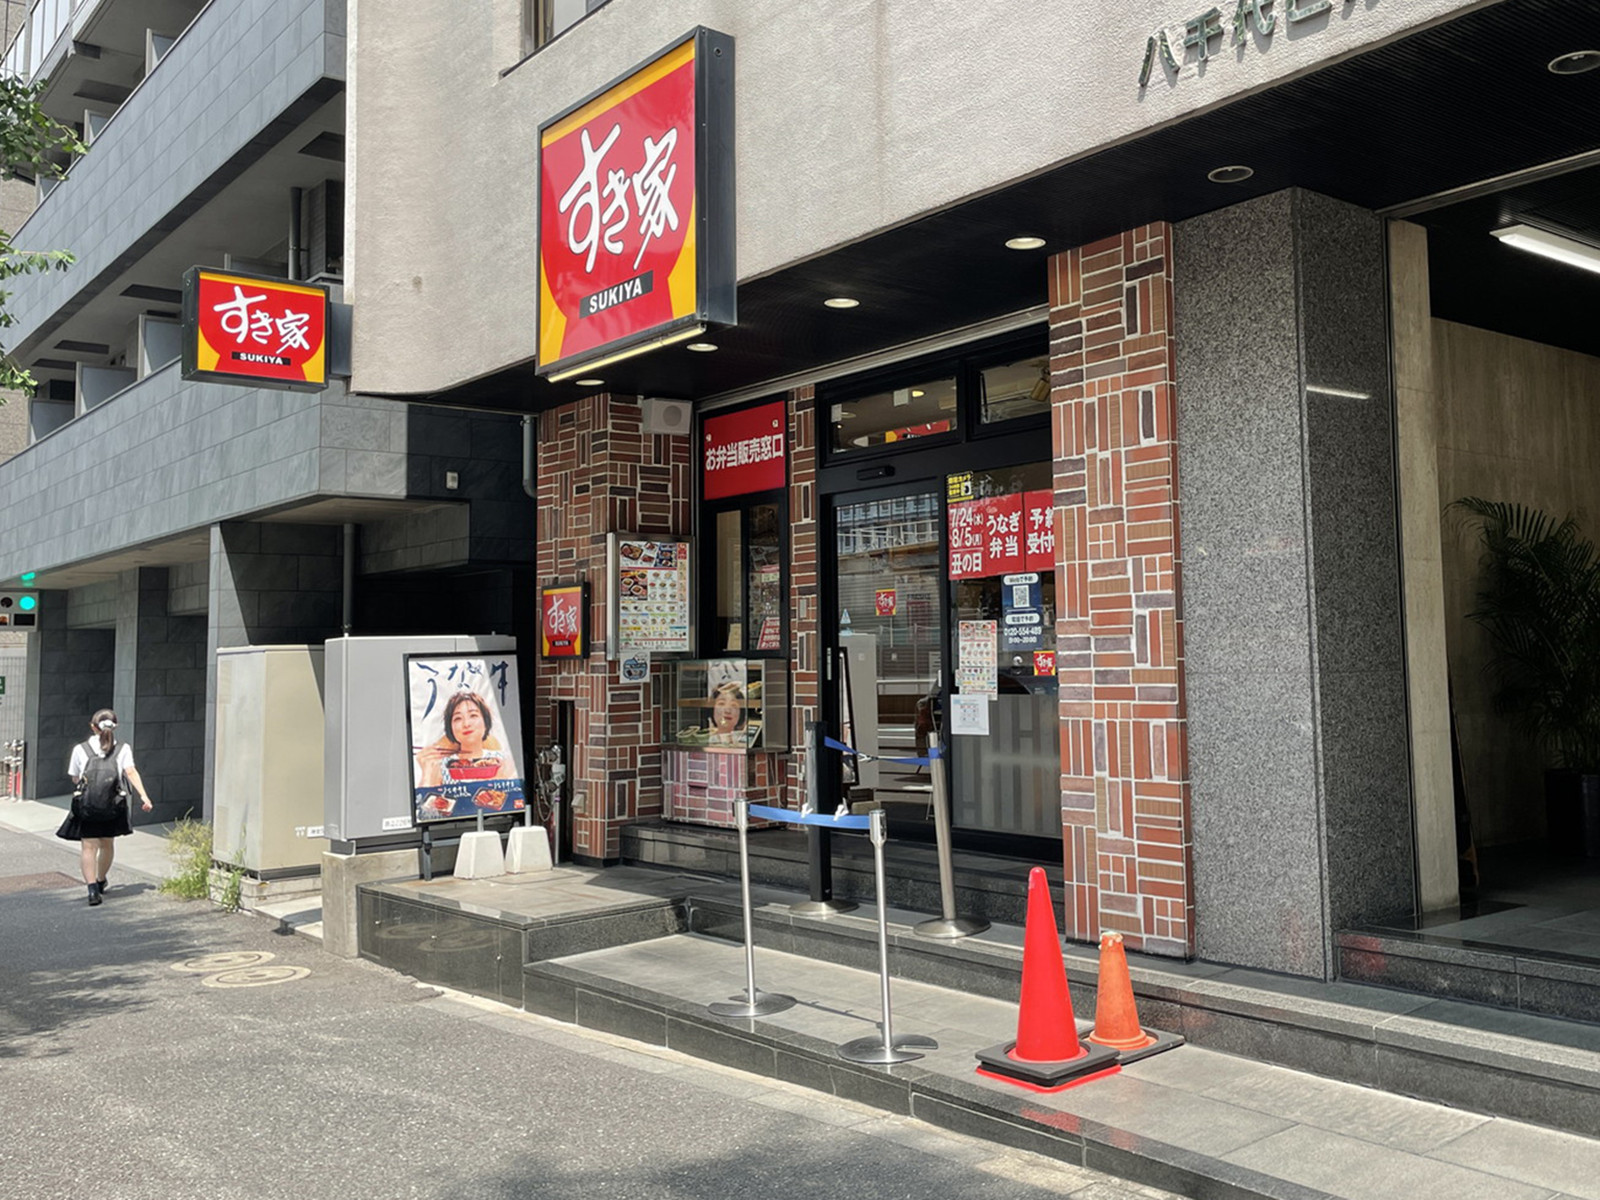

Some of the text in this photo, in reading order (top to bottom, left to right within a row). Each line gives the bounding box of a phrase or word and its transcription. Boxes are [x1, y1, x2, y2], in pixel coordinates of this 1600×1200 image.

[1138, 0, 1352, 86] 八千代
[559, 123, 680, 274] すき家
[588, 278, 644, 314] SUKIYA
[213, 285, 311, 354] すき家
[238, 352, 284, 365] SUKIYA
[705, 433, 784, 471] お弁当販売窓口
[986, 511, 1021, 536] うなぎ
[951, 552, 982, 574] 丑の日
[989, 535, 1019, 559] 弁当
[547, 595, 577, 638] すき家
